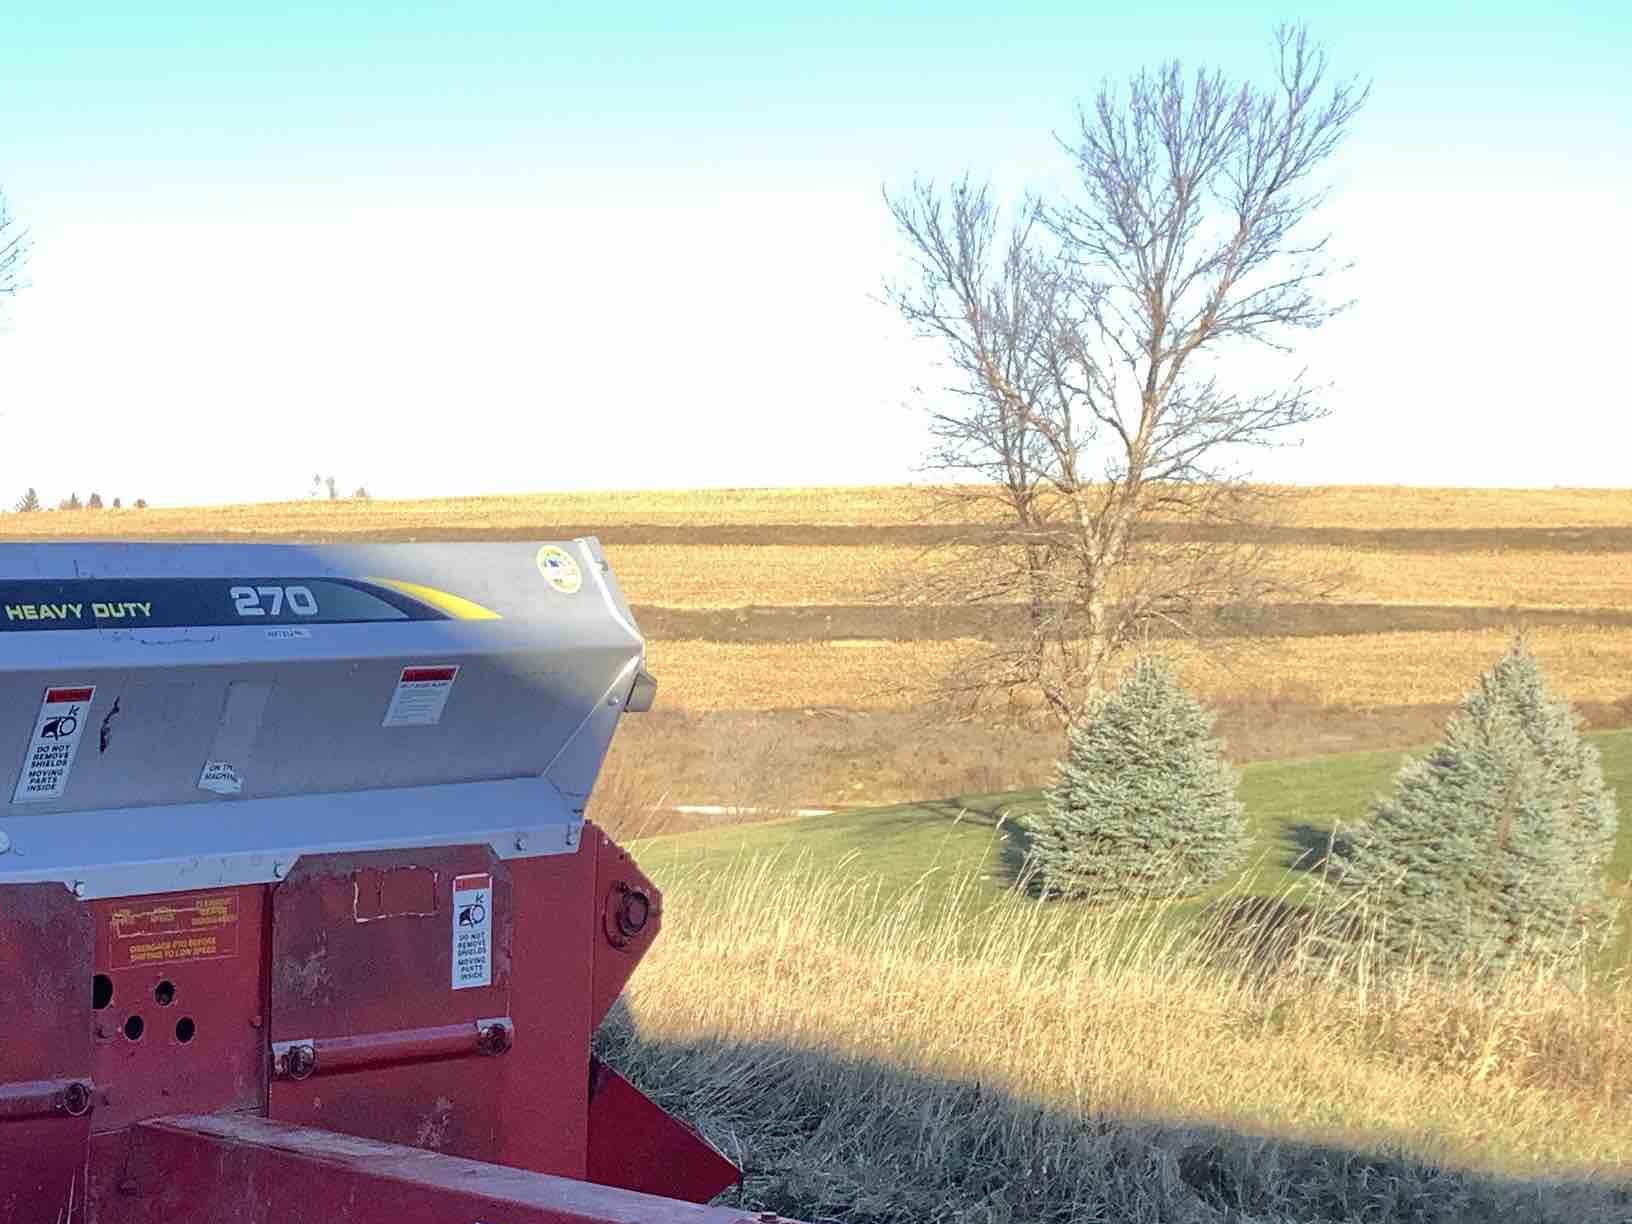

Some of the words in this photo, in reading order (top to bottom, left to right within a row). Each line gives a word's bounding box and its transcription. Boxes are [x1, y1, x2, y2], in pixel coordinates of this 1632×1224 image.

[4, 603, 83, 620] HEAVY
[92, 602, 152, 619] DUTY
[230, 586, 318, 616] 270
[36, 745, 49, 753] DO
[52, 744, 70, 752] NOT
[32, 752, 69, 761] REMOVE
[28, 769, 63, 777] MOVING
[27, 784, 57, 792] INSIDE
